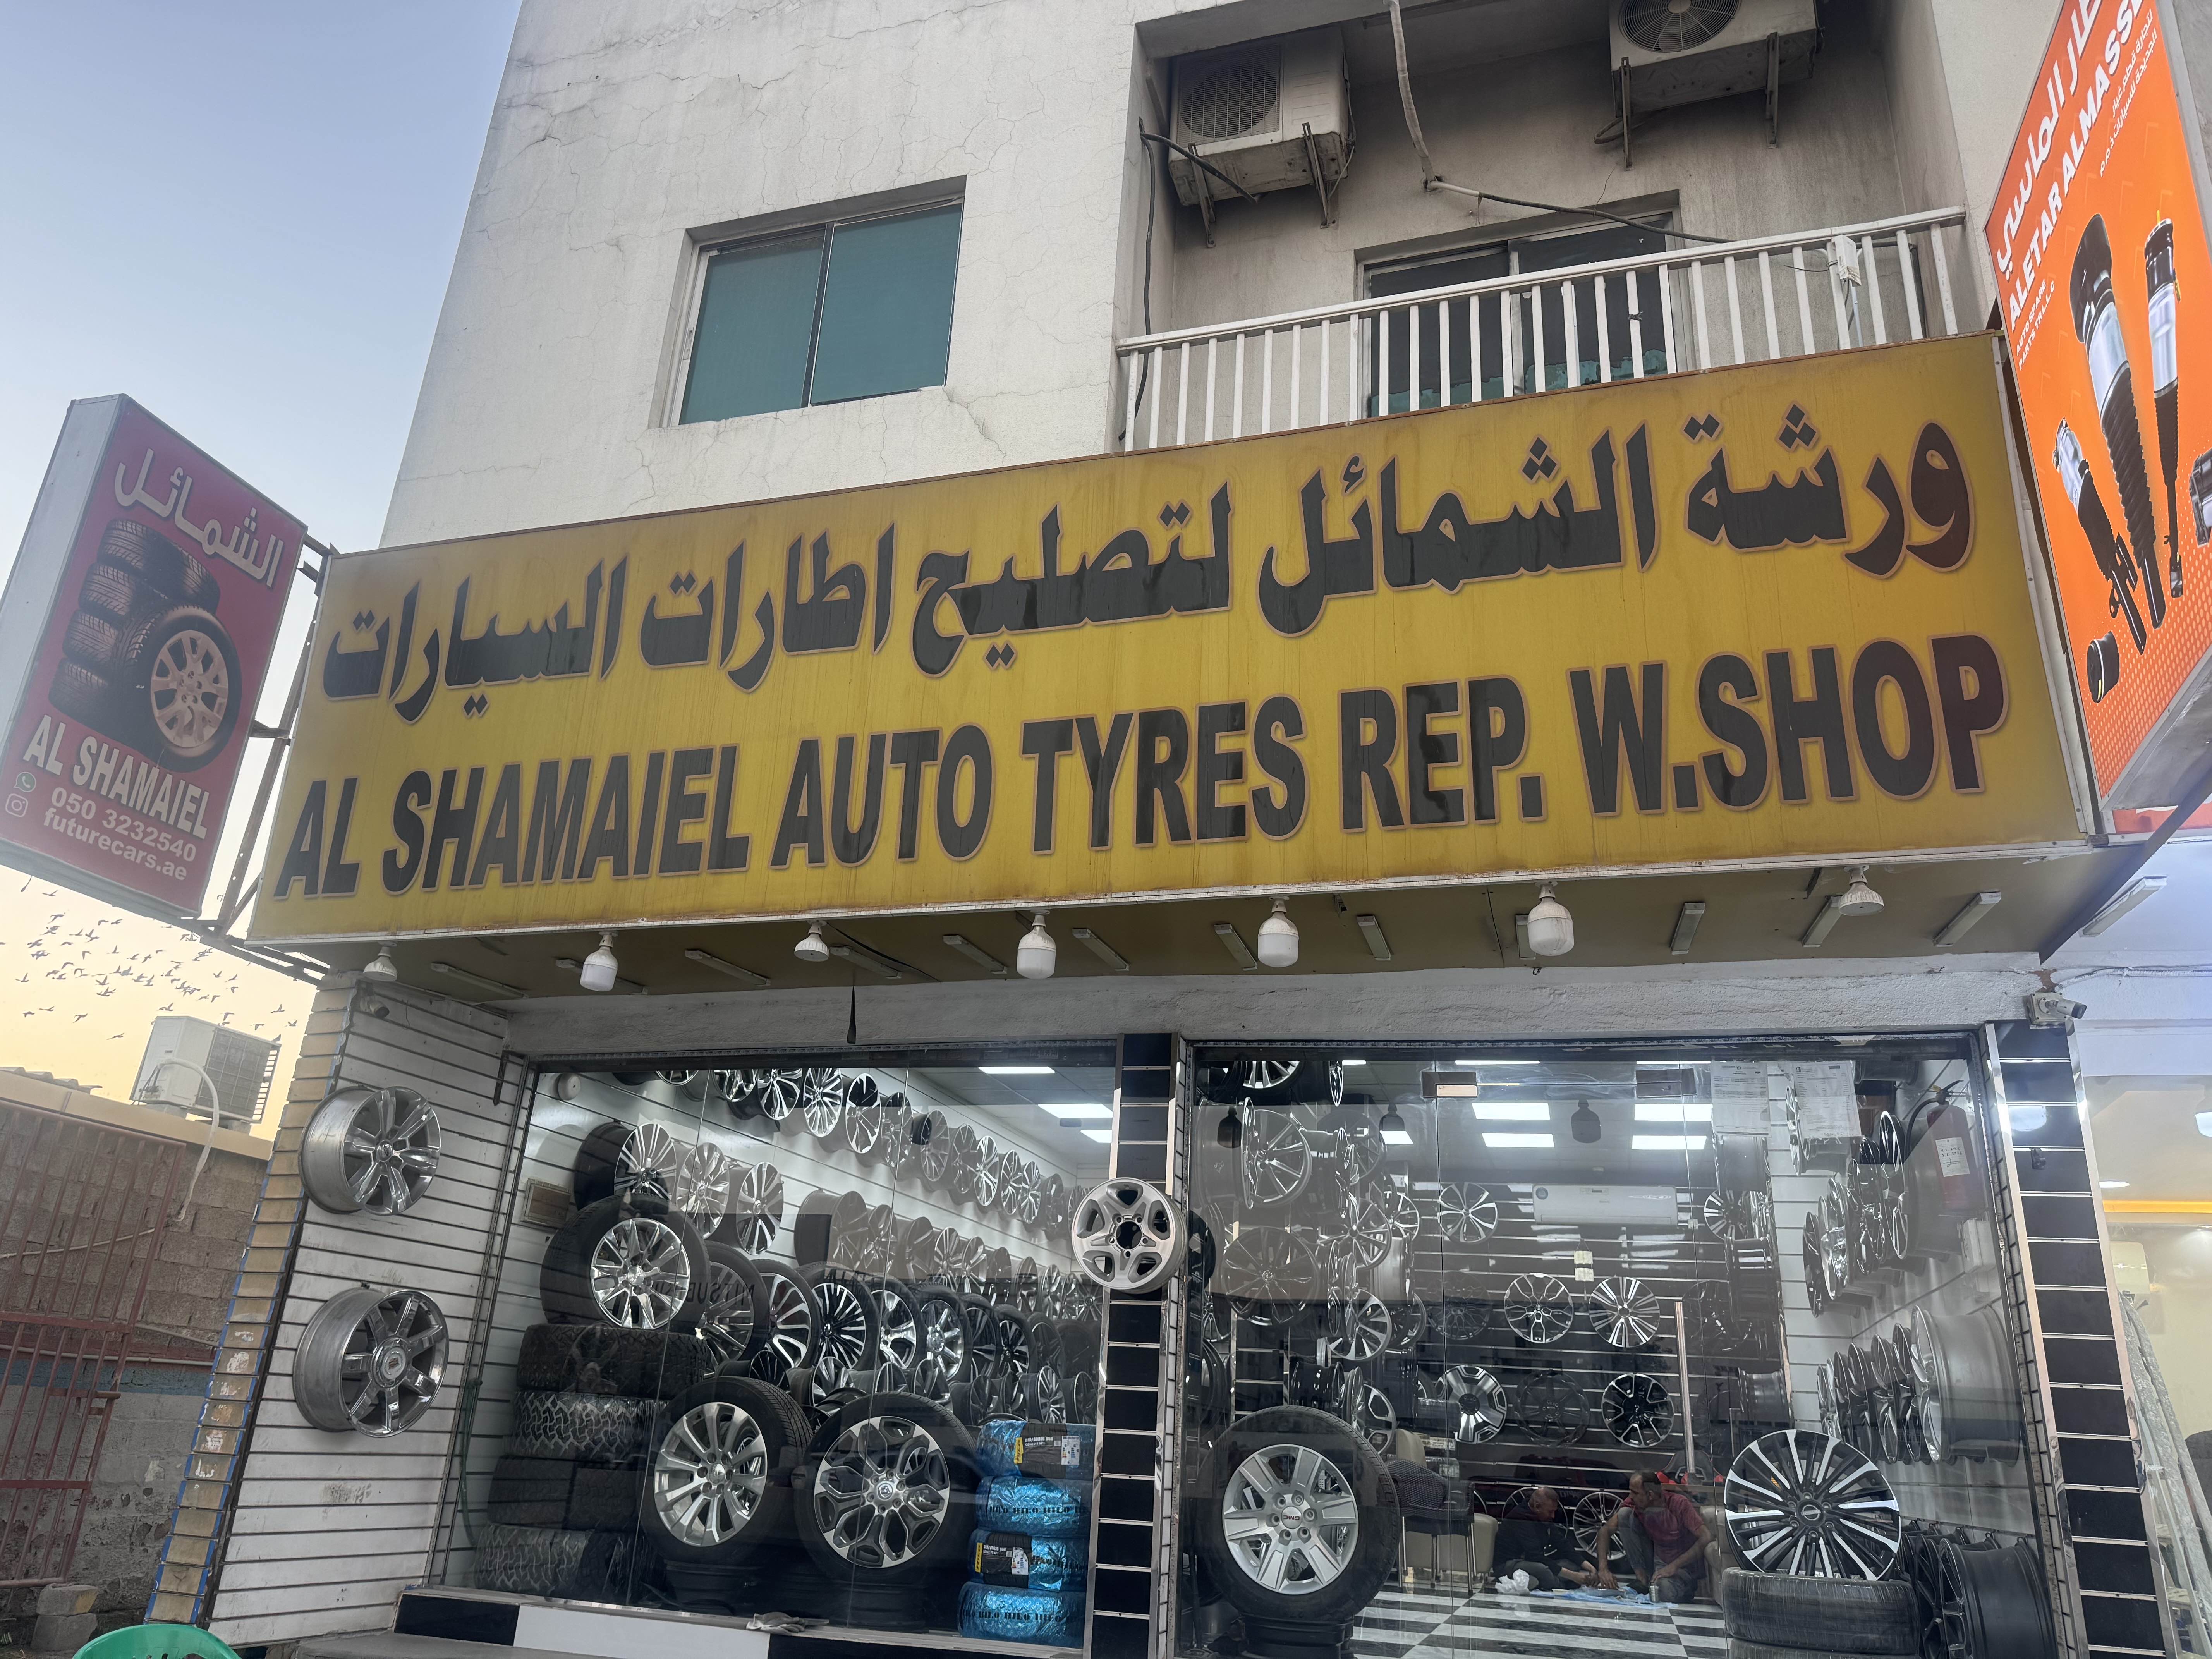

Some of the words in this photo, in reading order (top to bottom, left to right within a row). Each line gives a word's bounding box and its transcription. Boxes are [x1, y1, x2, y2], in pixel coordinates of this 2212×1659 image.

[2009, 181, 2063, 333] ALETAR
[2016, 321, 2030, 356] AUTO
[2028, 278, 2046, 323] SPARE
[2018, 328, 2035, 371] PARTS
[113, 448, 285, 587] الشمائل
[1258, 422, 1658, 636] الشمائل
[1685, 401, 1975, 578] ورشة
[321, 552, 627, 725] السيارات
[640, 521, 896, 693] اطارات
[911, 480, 1234, 678] لتصليح
[22, 714, 66, 775] AL
[73, 736, 210, 840] SHAMAIEL
[51, 787, 96, 820] 050
[102, 809, 197, 862] 3232540
[274, 777, 361, 899] AL
[383, 744, 751, 895] SHAMAIEL
[770, 723, 994, 869] AUTO
[1020, 692, 1310, 855] TYRES
[1337, 674, 1546, 833] REP.
[1566, 632, 2008, 817] W.SHOP
[43, 808, 187, 881] futurecars.ae
